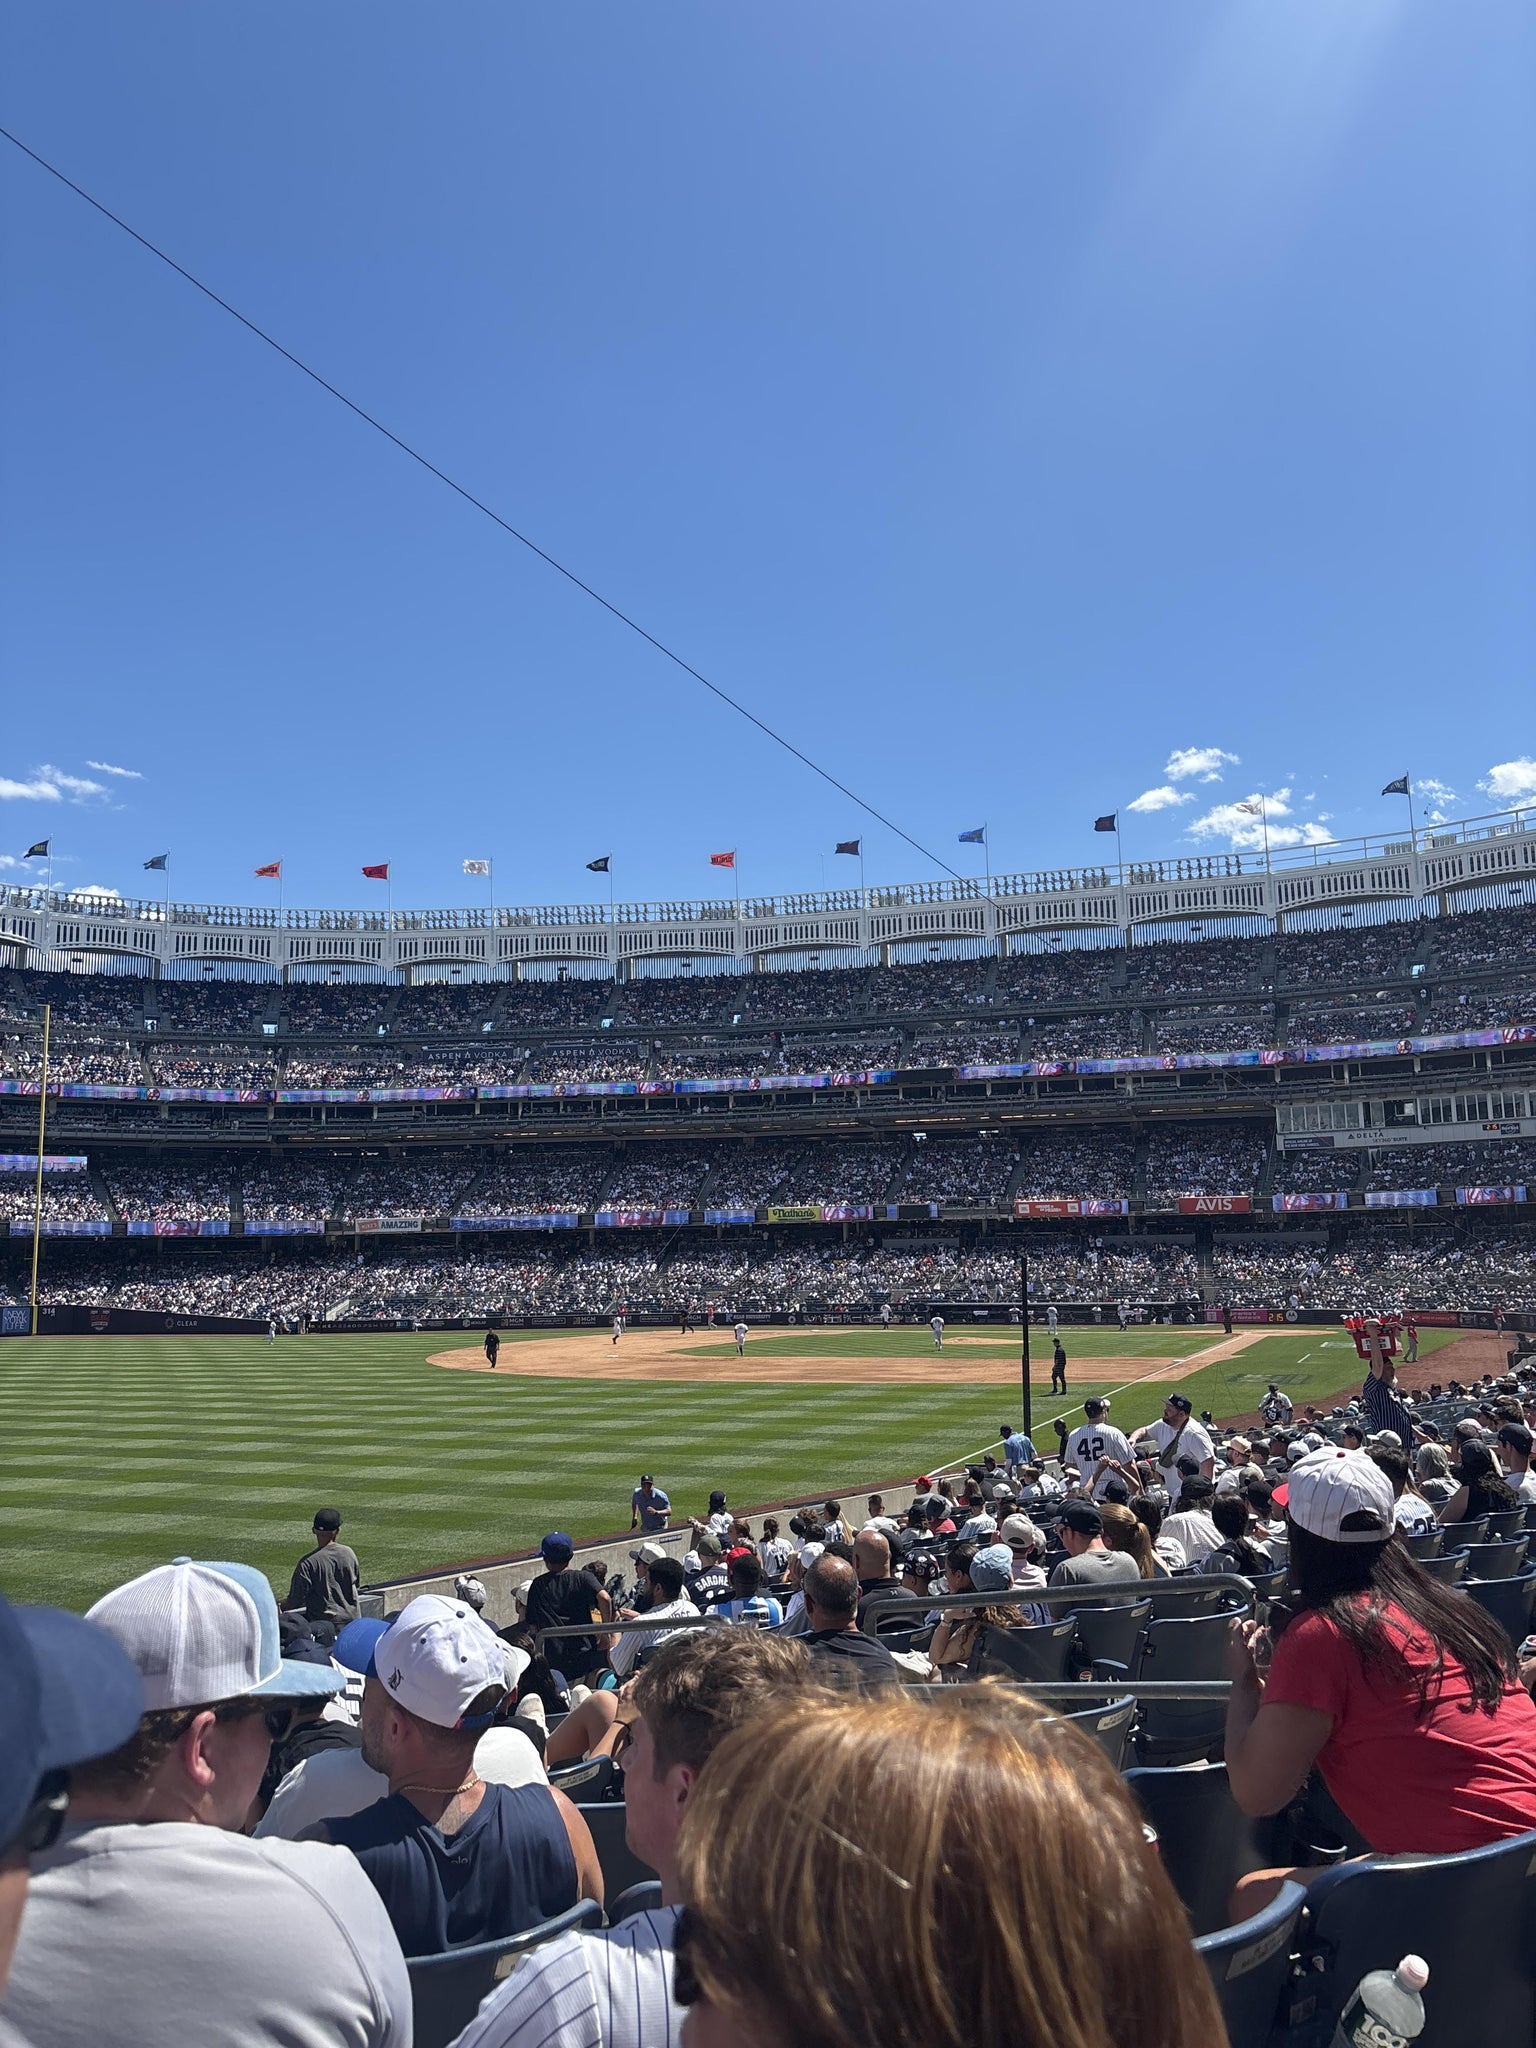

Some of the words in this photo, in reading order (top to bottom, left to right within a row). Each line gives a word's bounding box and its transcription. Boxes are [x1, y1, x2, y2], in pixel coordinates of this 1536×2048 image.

[1195, 1199, 1233, 1211] AVIS
[773, 1208, 816, 1219] Nathan's
[381, 1220, 418, 1229] AMAZING
[7, 1322, 25, 1330] LIFE
[1077, 1437, 1105, 1462] 42
[695, 1575, 730, 1592] GARDNE
